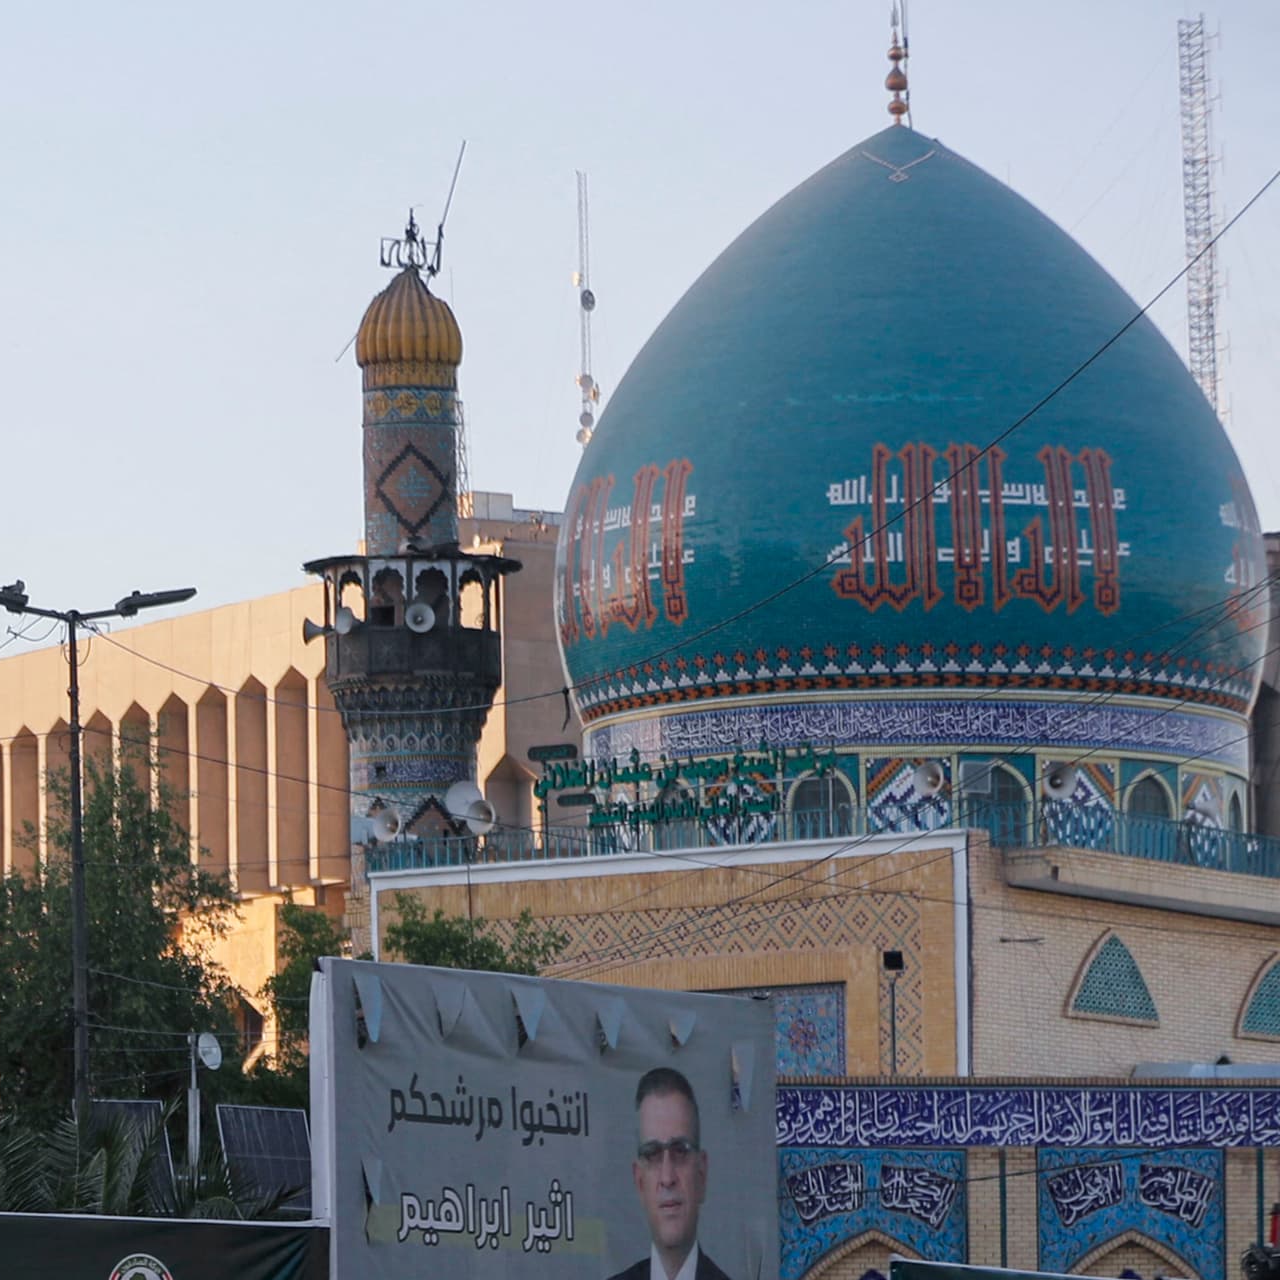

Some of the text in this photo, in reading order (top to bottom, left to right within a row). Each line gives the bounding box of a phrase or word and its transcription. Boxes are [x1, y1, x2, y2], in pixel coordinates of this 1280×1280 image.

[387, 1072, 589, 1147] انتخبوا مرشحكم
[398, 1183, 510, 1250] ابراهيم
